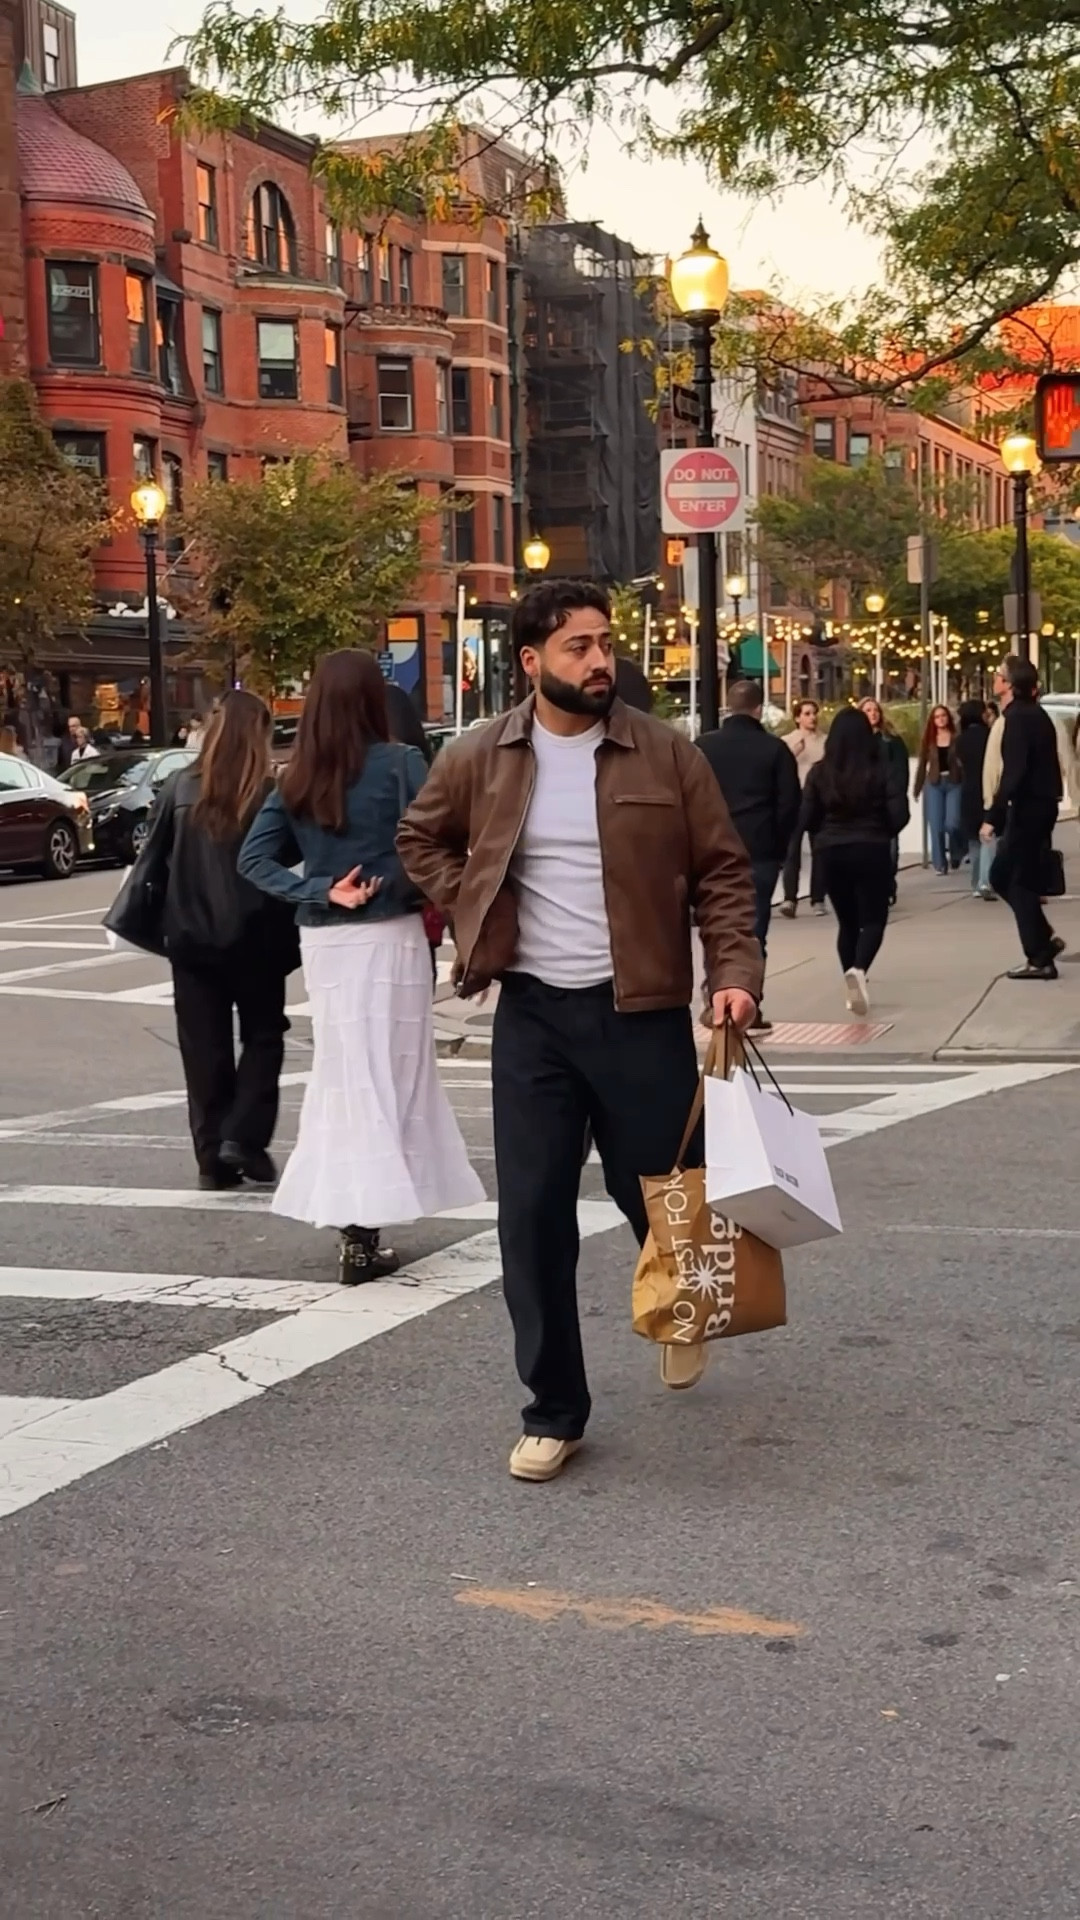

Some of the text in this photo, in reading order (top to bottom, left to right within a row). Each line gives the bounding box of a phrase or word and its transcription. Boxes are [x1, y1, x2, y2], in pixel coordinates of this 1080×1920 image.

[674, 467, 731, 480] DO NOT
[680, 500, 726, 512] ENTER
[663, 1173, 696, 1343] NO REST FOR
[702, 1212, 742, 1339] Bridg
